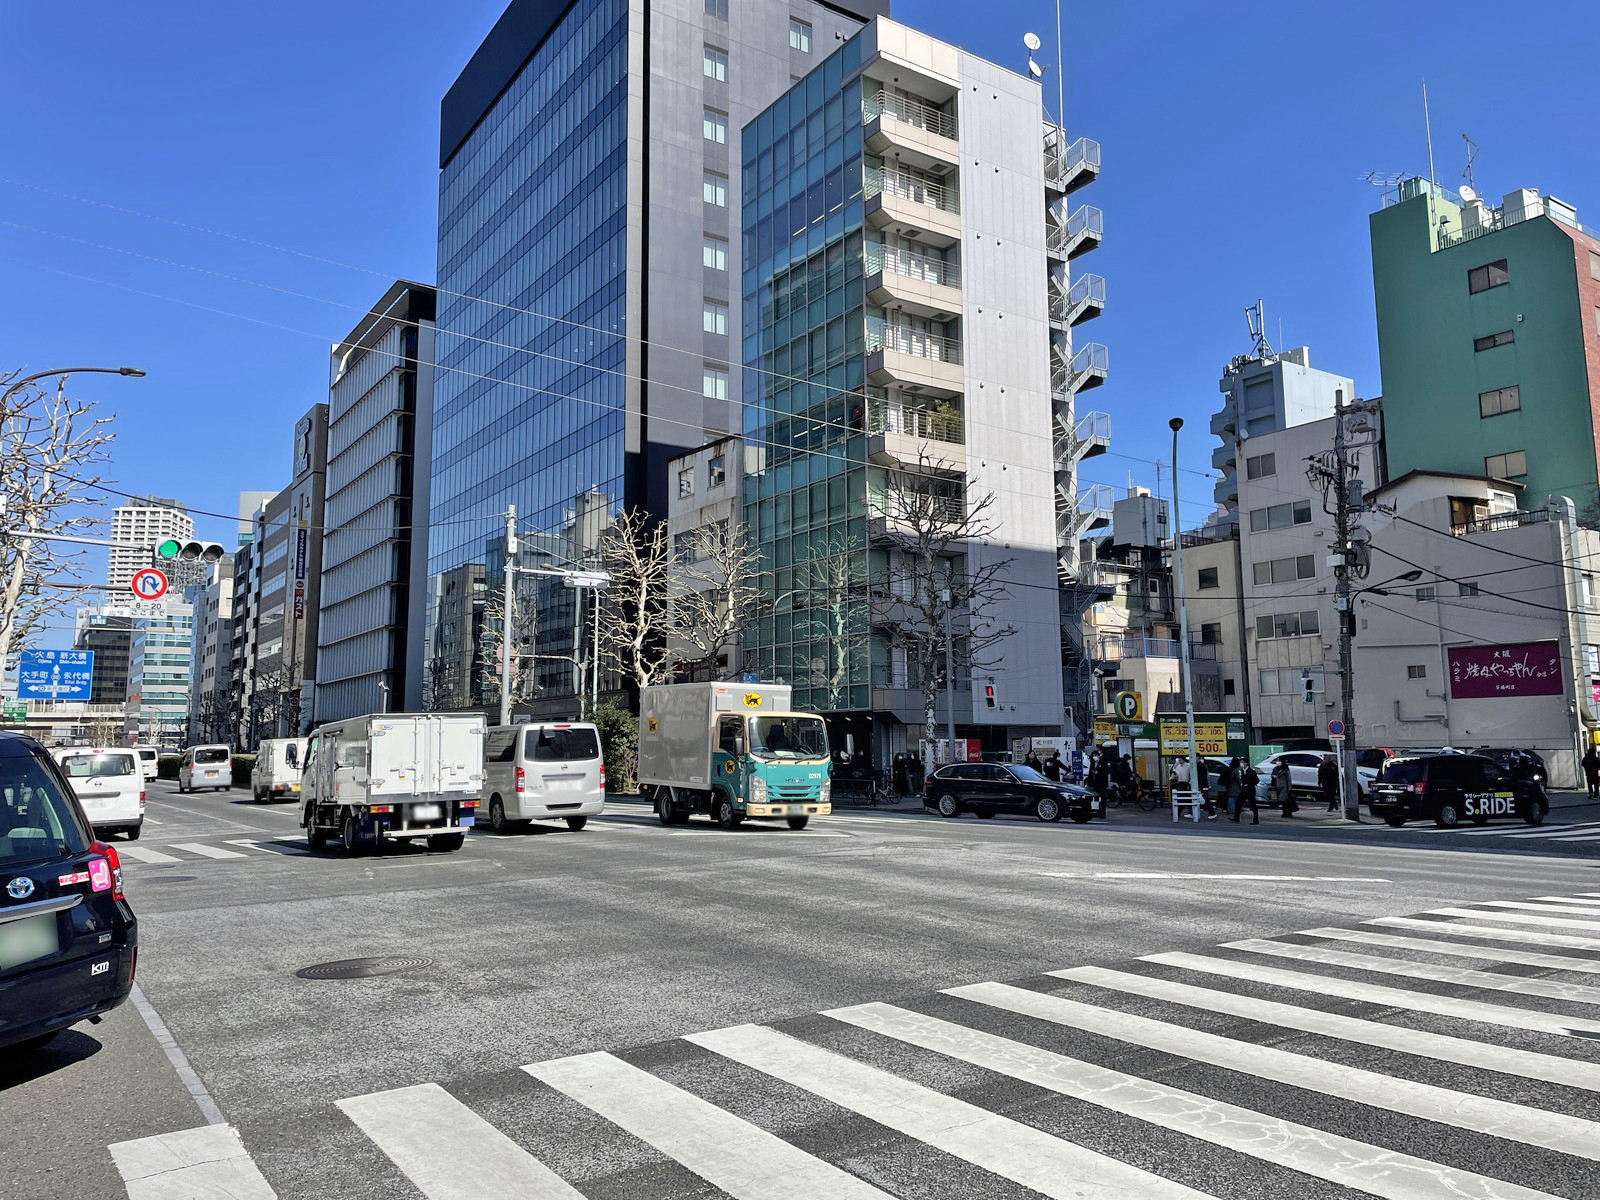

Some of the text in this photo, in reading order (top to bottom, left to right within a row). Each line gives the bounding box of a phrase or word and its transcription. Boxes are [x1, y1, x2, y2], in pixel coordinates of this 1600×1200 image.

[295, 596, 303, 618] ガスト
[59, 652, 87, 660] 新大橋
[1493, 649, 1511, 658] 大阪
[20, 670, 49, 680] 大手町
[1452, 661, 1461, 682] ハラミ
[1549, 658, 1557, 675] タン
[63, 672, 91, 680] 永代橋
[1125, 697, 1136, 716] P
[1465, 797, 1516, 816] S.RIDE
